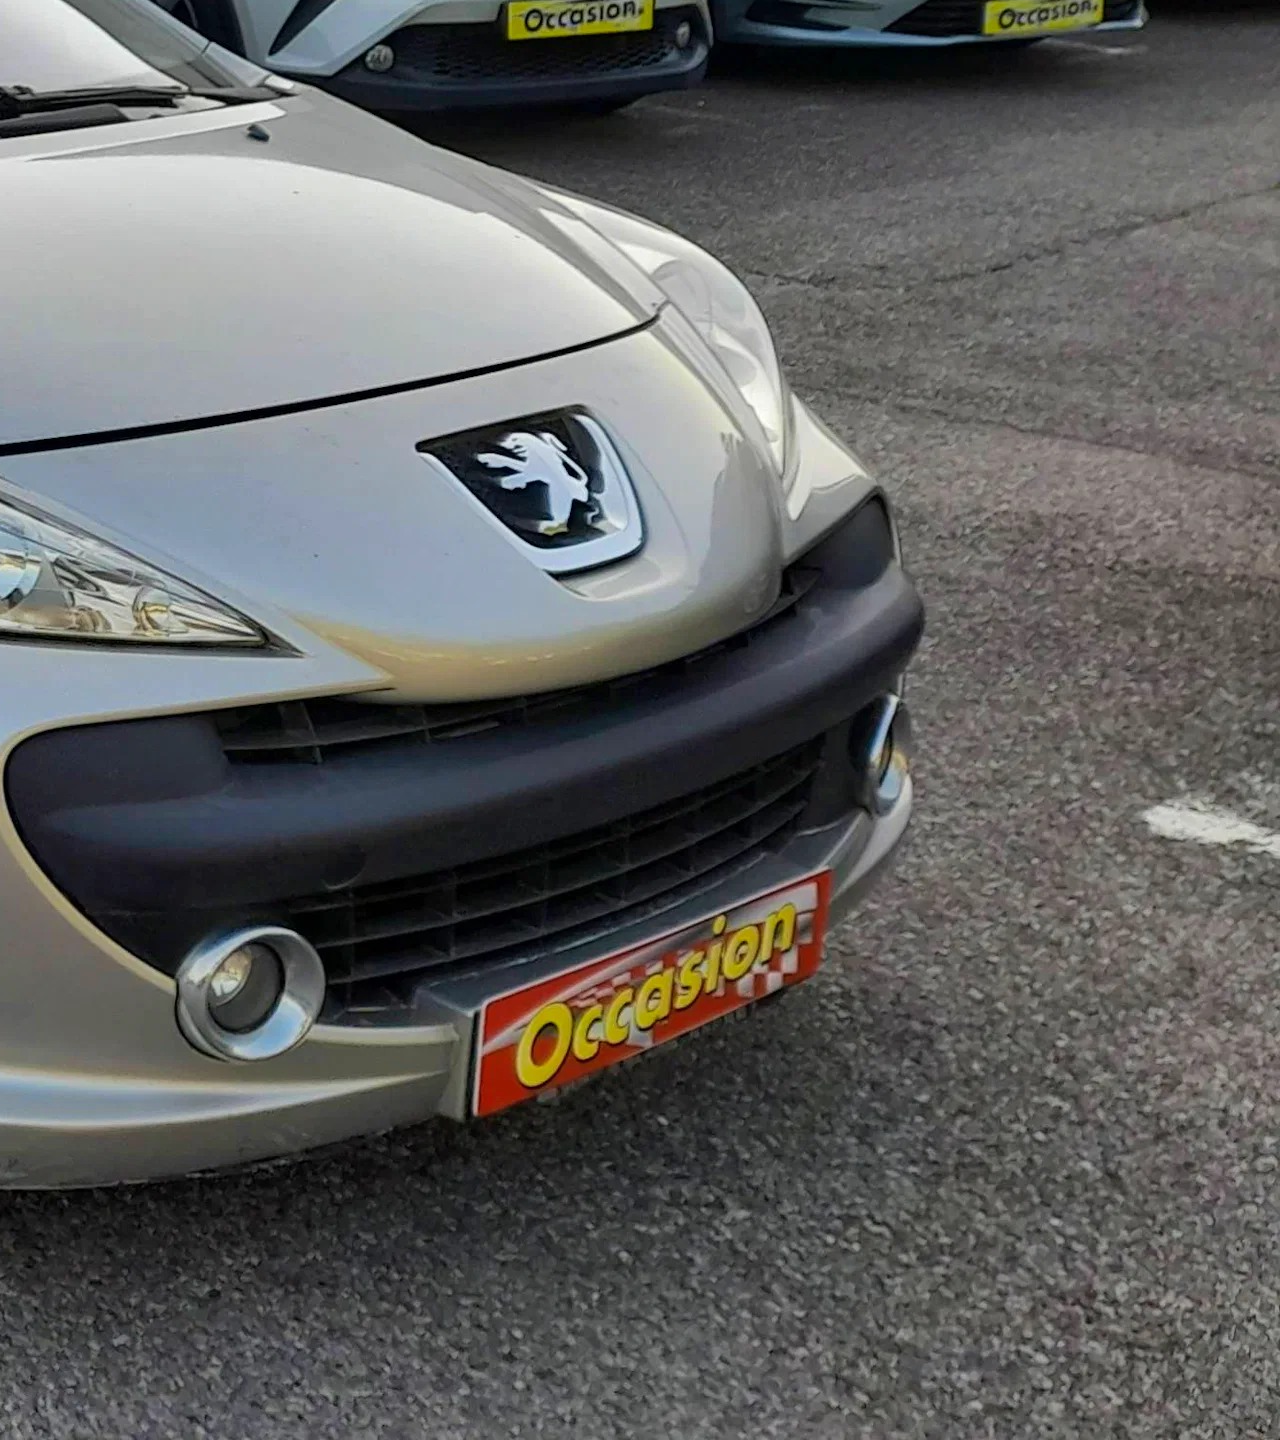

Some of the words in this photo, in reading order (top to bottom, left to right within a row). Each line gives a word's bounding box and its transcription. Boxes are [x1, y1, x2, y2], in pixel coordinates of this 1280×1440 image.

[524, 0, 637, 32] Occasion
[999, 0, 1093, 30] Occasion
[515, 902, 797, 1089] Occasion
